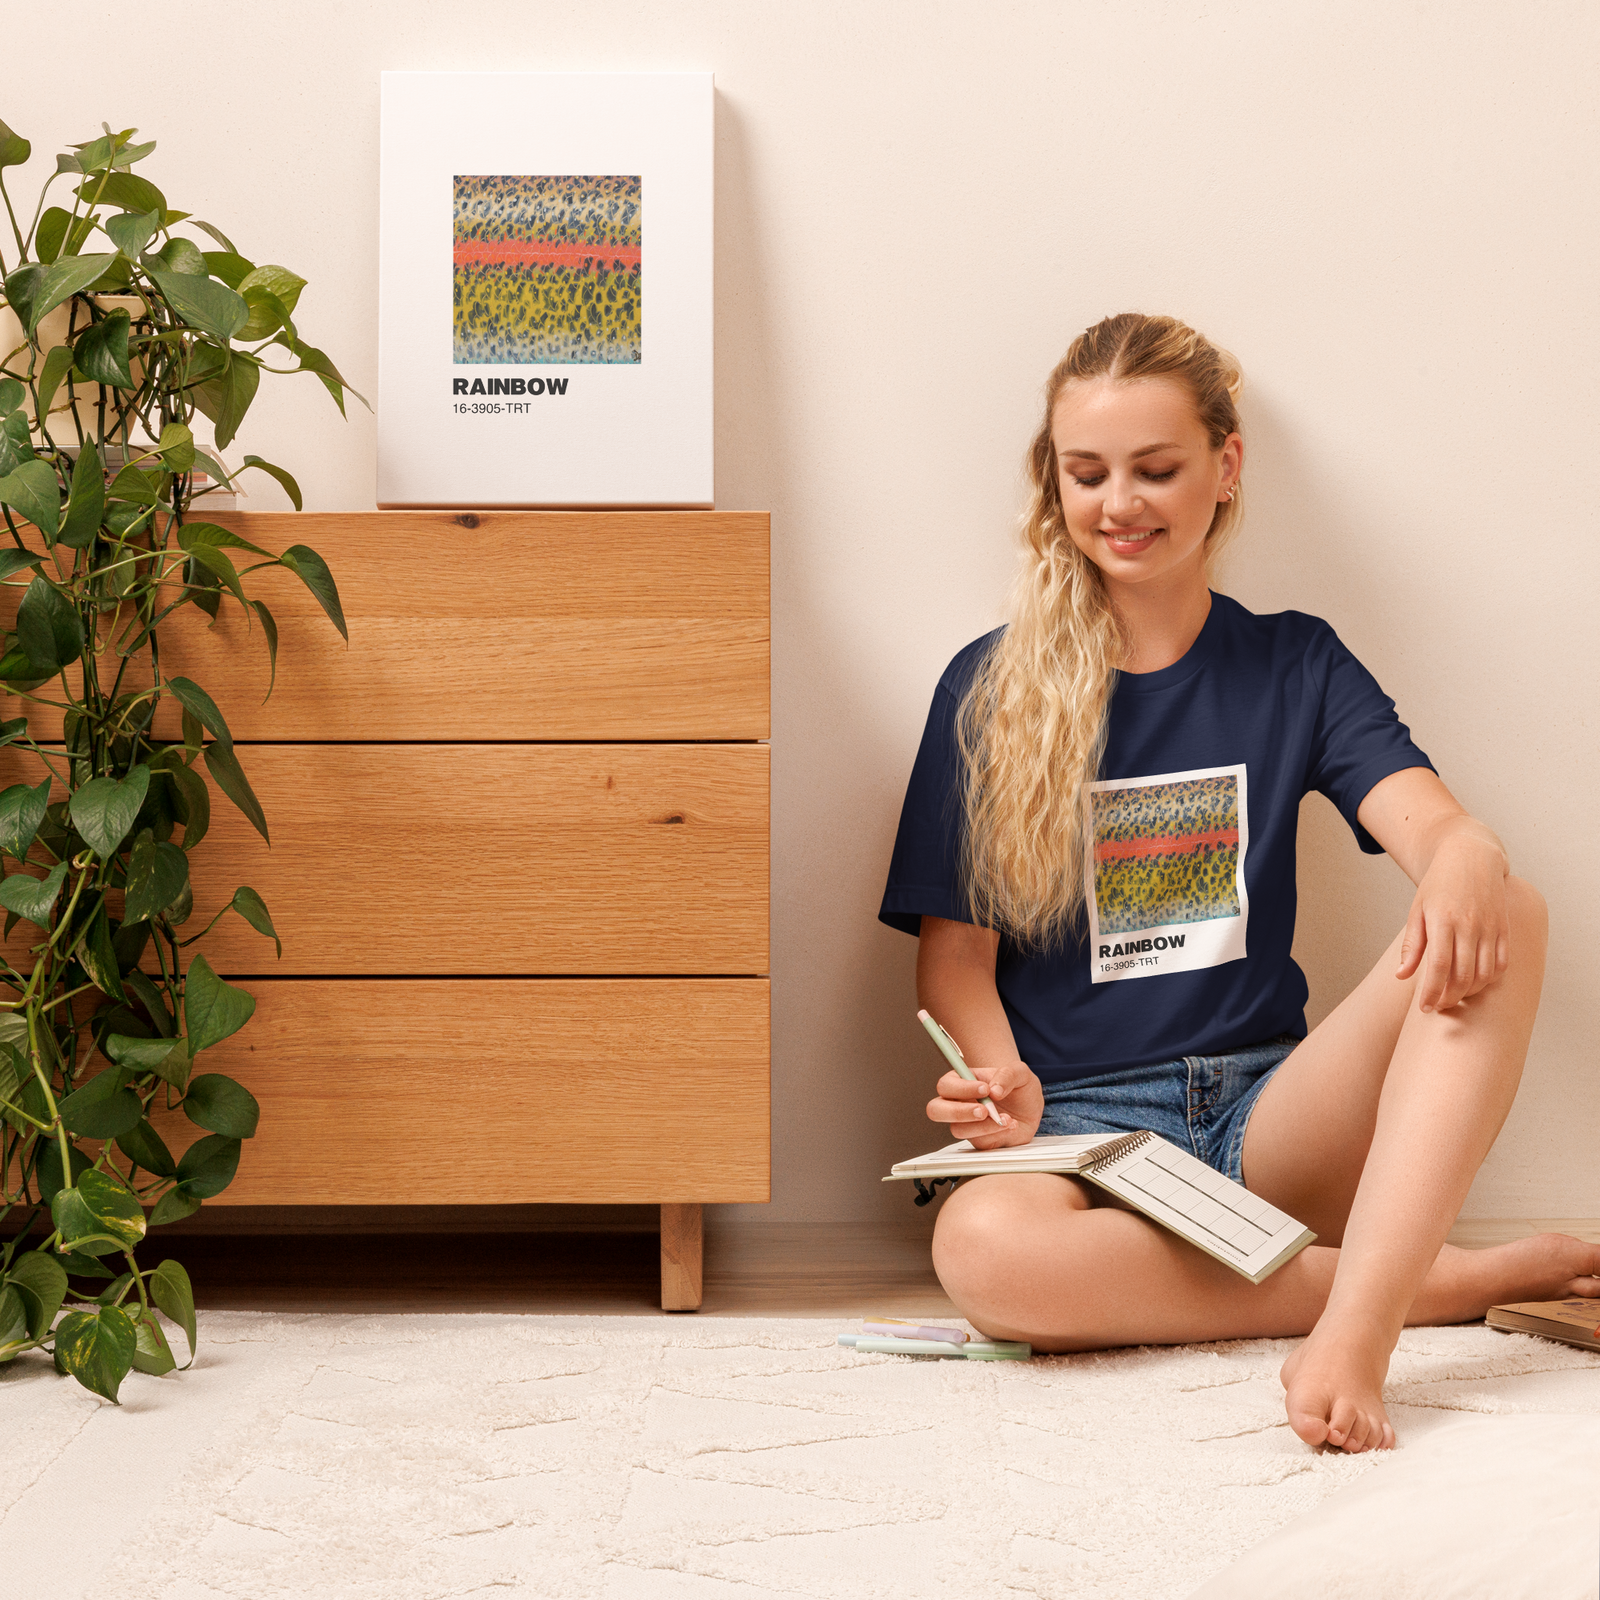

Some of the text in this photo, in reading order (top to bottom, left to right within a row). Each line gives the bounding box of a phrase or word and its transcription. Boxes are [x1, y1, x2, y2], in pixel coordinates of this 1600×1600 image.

[453, 378, 569, 395] RAINBOW
[453, 403, 531, 414] 16-3905-TRT
[1099, 934, 1186, 958] RAINBOW
[1100, 956, 1159, 972] 16-3905-TRT
